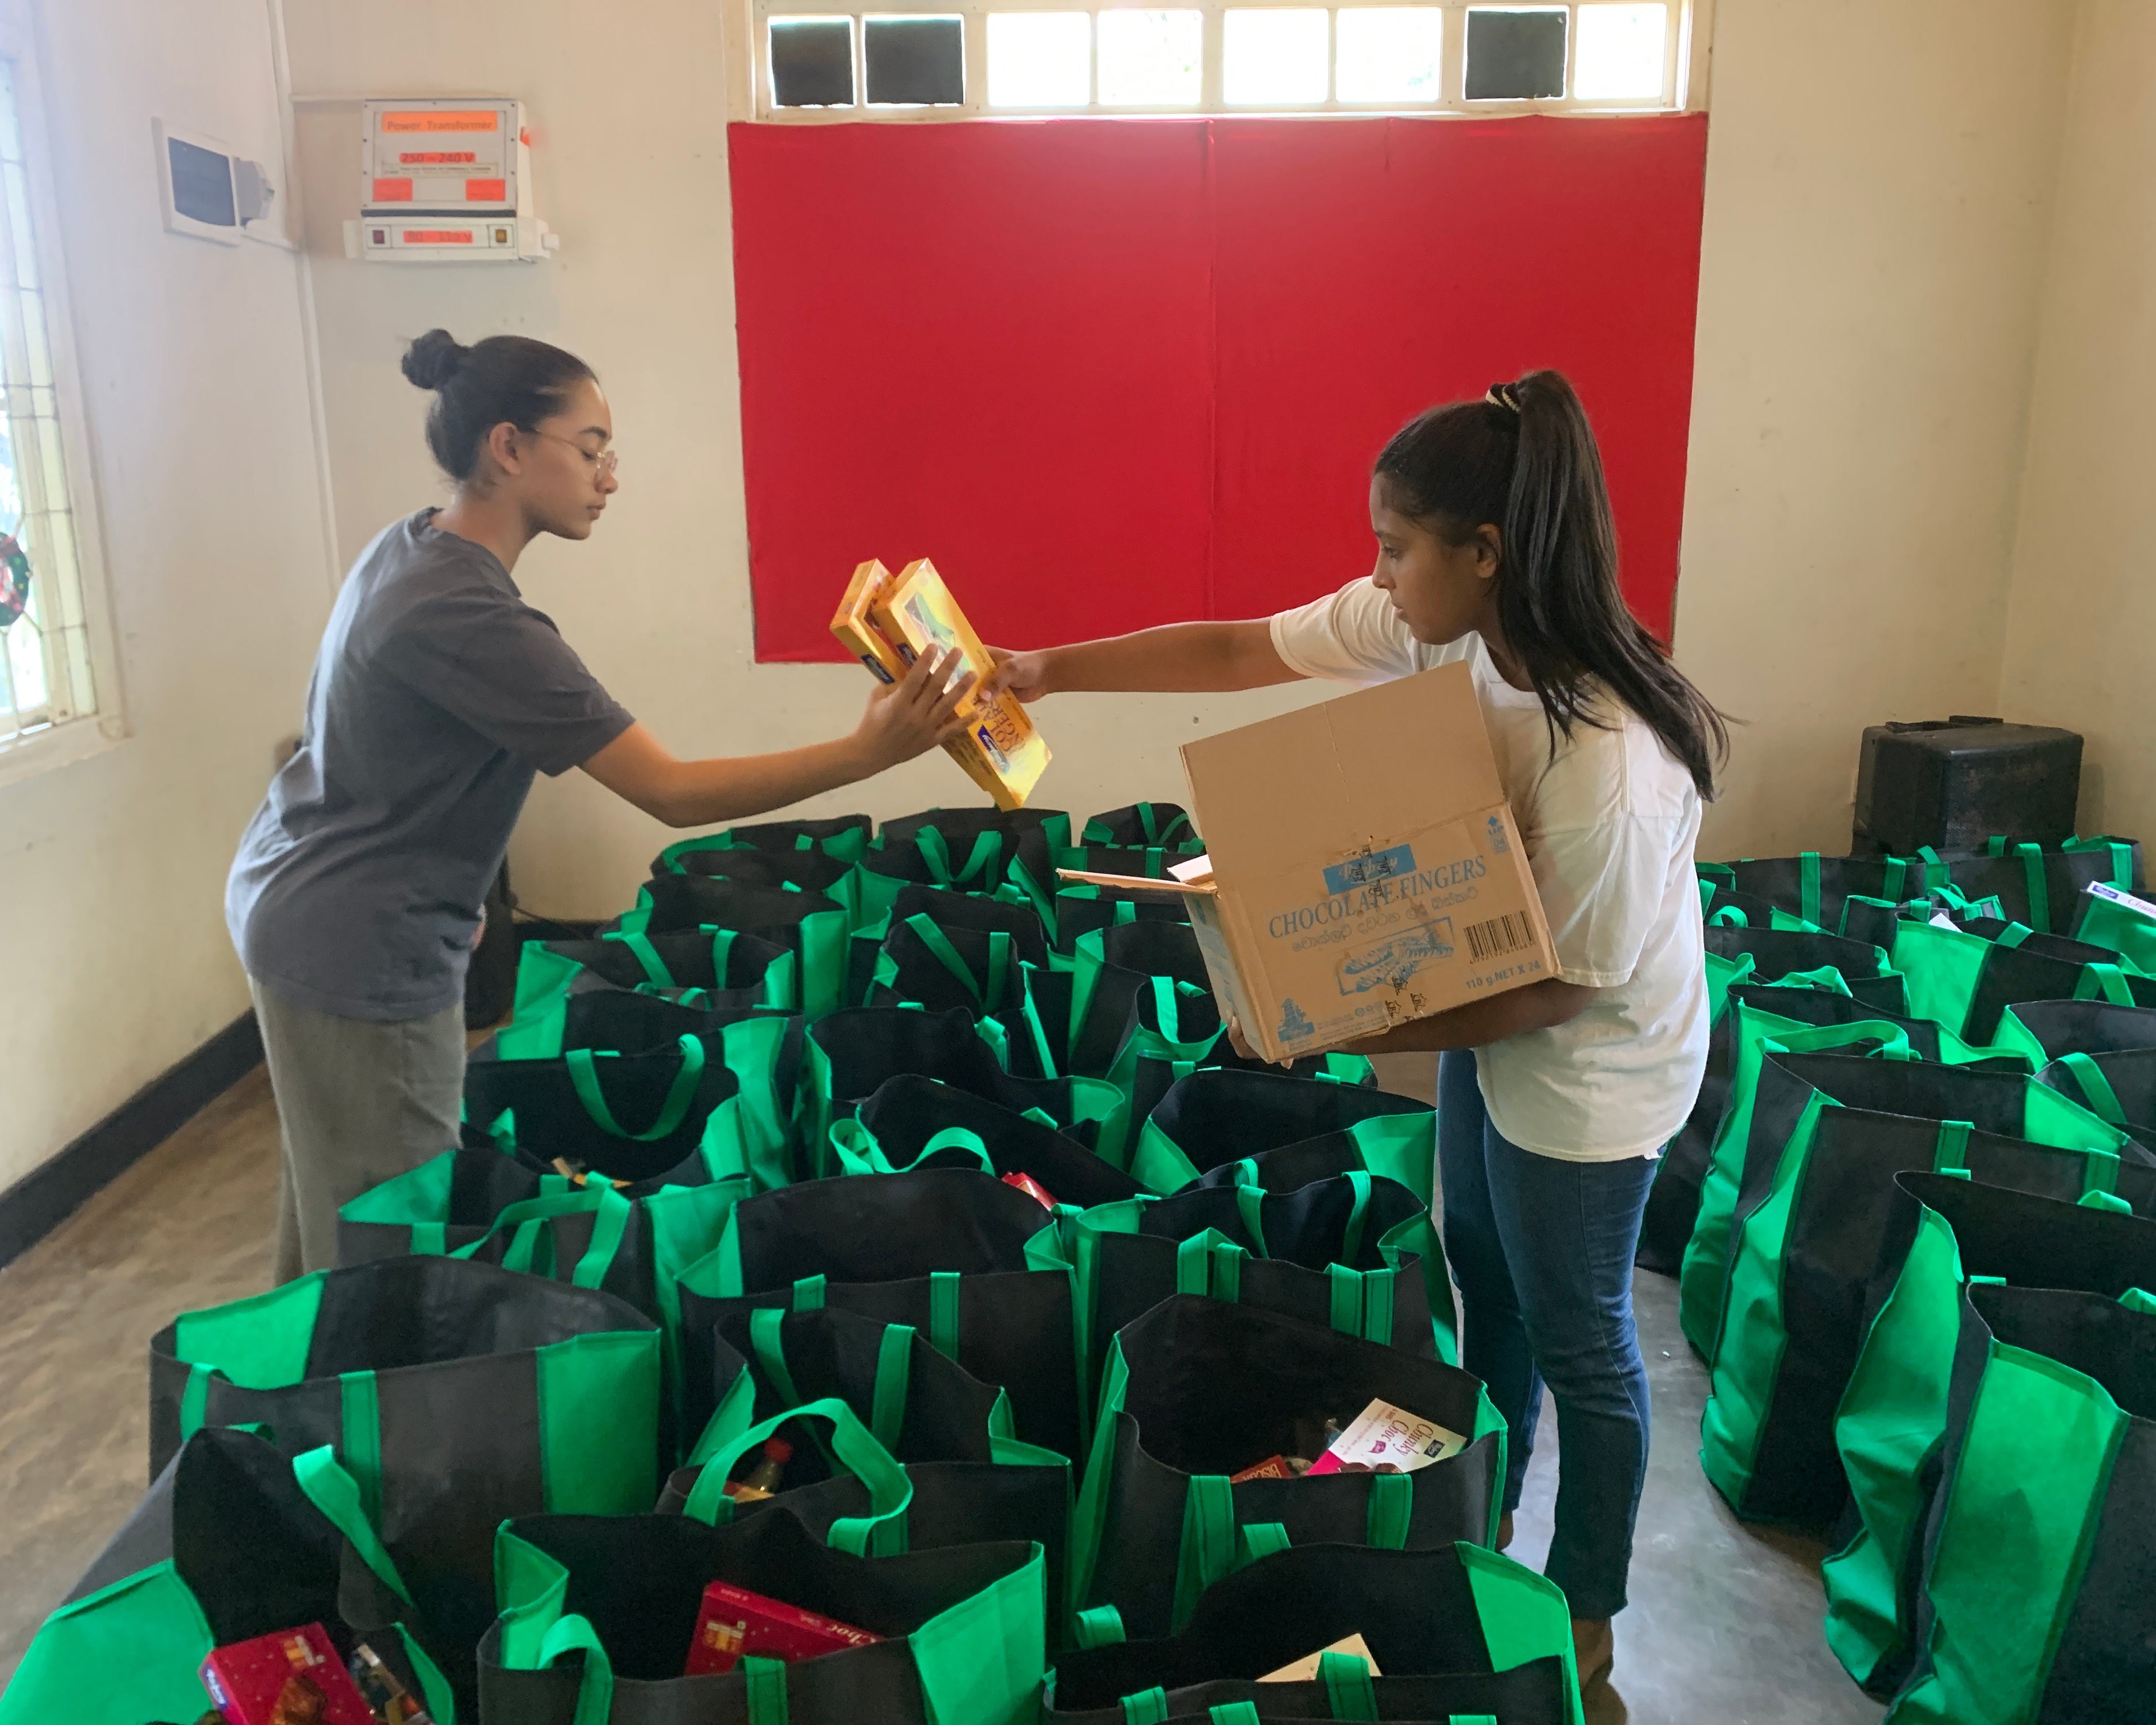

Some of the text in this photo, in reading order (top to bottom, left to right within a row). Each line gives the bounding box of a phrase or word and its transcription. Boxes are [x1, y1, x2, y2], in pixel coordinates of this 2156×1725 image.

[387, 120, 492, 130] Power Transformer
[464, 152, 474, 163] V
[1269, 855, 1488, 939] CHOCOLATE FINGERS
[1466, 977, 1483, 990] 110
[1486, 976, 1494, 986] g
[1494, 967, 1514, 981] NET
[1381, 1420, 1409, 1441] Choc
[1392, 1423, 1434, 1456] Chunky
